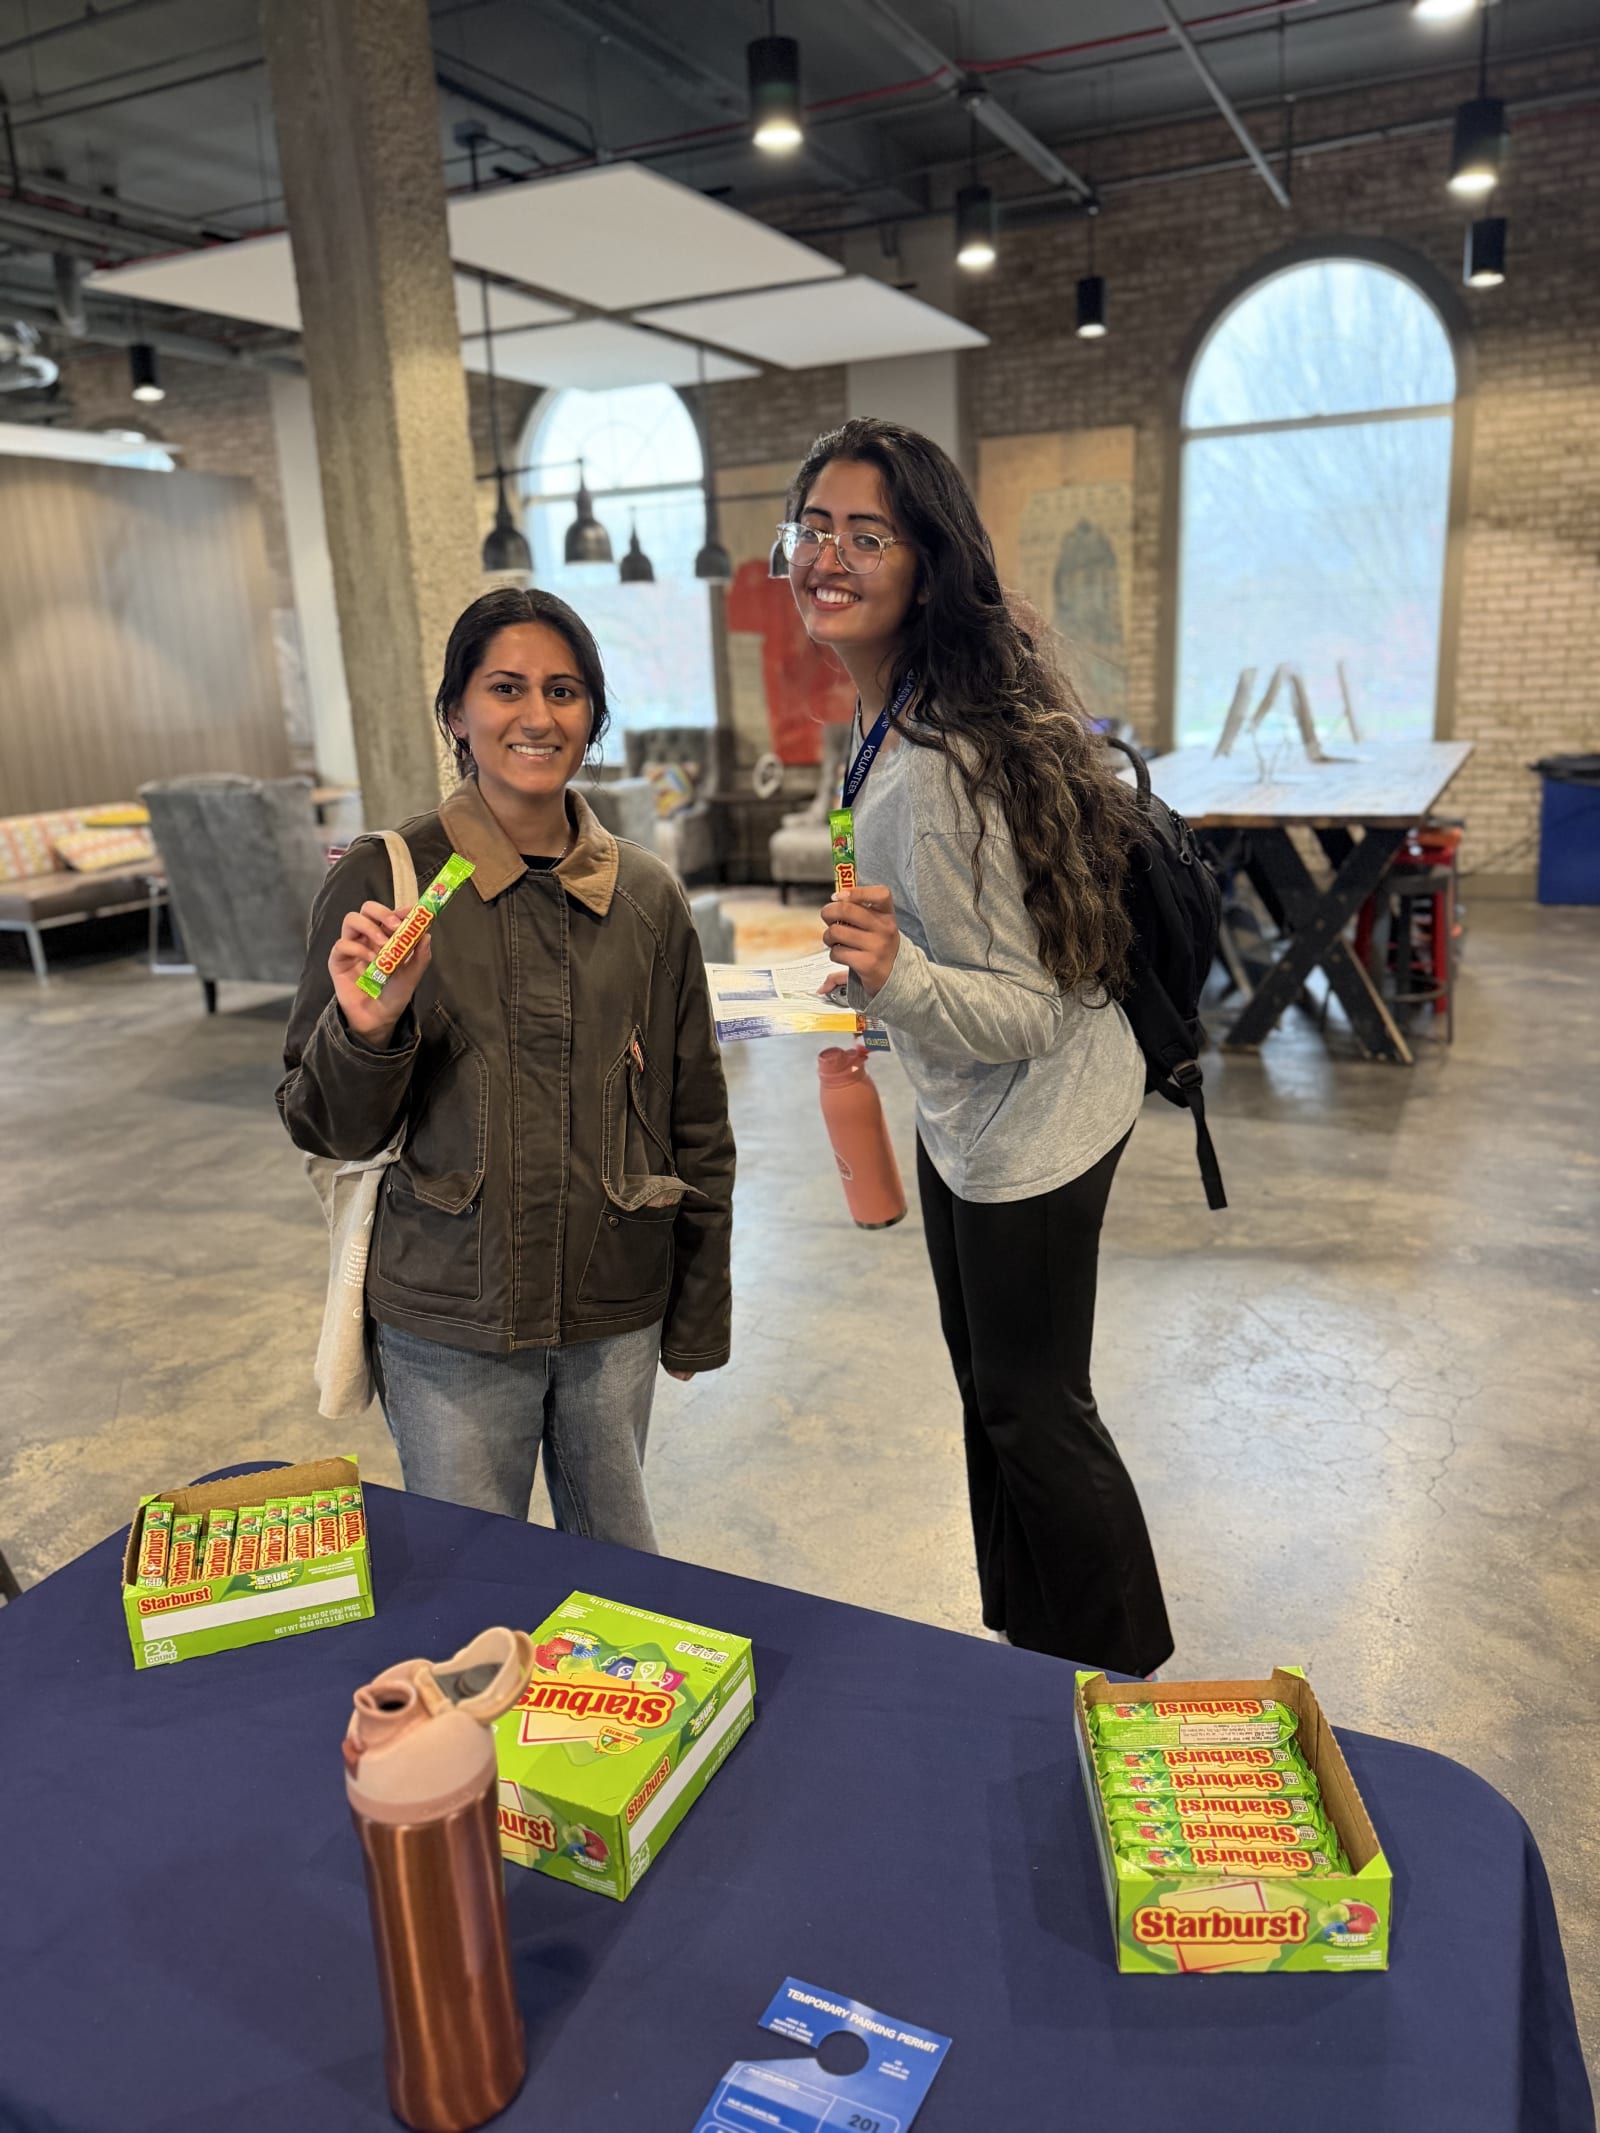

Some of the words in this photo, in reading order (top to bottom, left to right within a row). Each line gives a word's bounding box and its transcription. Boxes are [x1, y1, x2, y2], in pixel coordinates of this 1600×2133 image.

[847, 745, 876, 795] VOLUNTEER
[378, 907, 431, 973] Starburst
[256, 1571, 289, 1585] SOUR
[140, 1589, 209, 1612] Starburst
[274, 1627, 287, 1635] NET
[287, 1624, 299, 1632] WT
[145, 1640, 174, 1656] 24
[147, 1652, 177, 1664] COUNT
[517, 1686, 662, 1724] Starburs
[1157, 1700, 1260, 1716] Starburst
[1166, 1750, 1271, 1766] Starburst
[628, 1759, 670, 1820] Starburst
[1174, 1772, 1281, 1790] Starburst
[1179, 1798, 1289, 1815] Starburst
[1185, 1824, 1297, 1842] Starburst
[1194, 1849, 1310, 1869] Starburst
[1140, 1909, 1303, 1937] Starburst
[1336, 1933, 1366, 1943] SOUR
[787, 1988, 850, 2019] TEMPORARY
[849, 2013, 897, 2040] PARKING
[897, 2032, 940, 2053] PERMIT
[847, 2113, 881, 2133] 201
